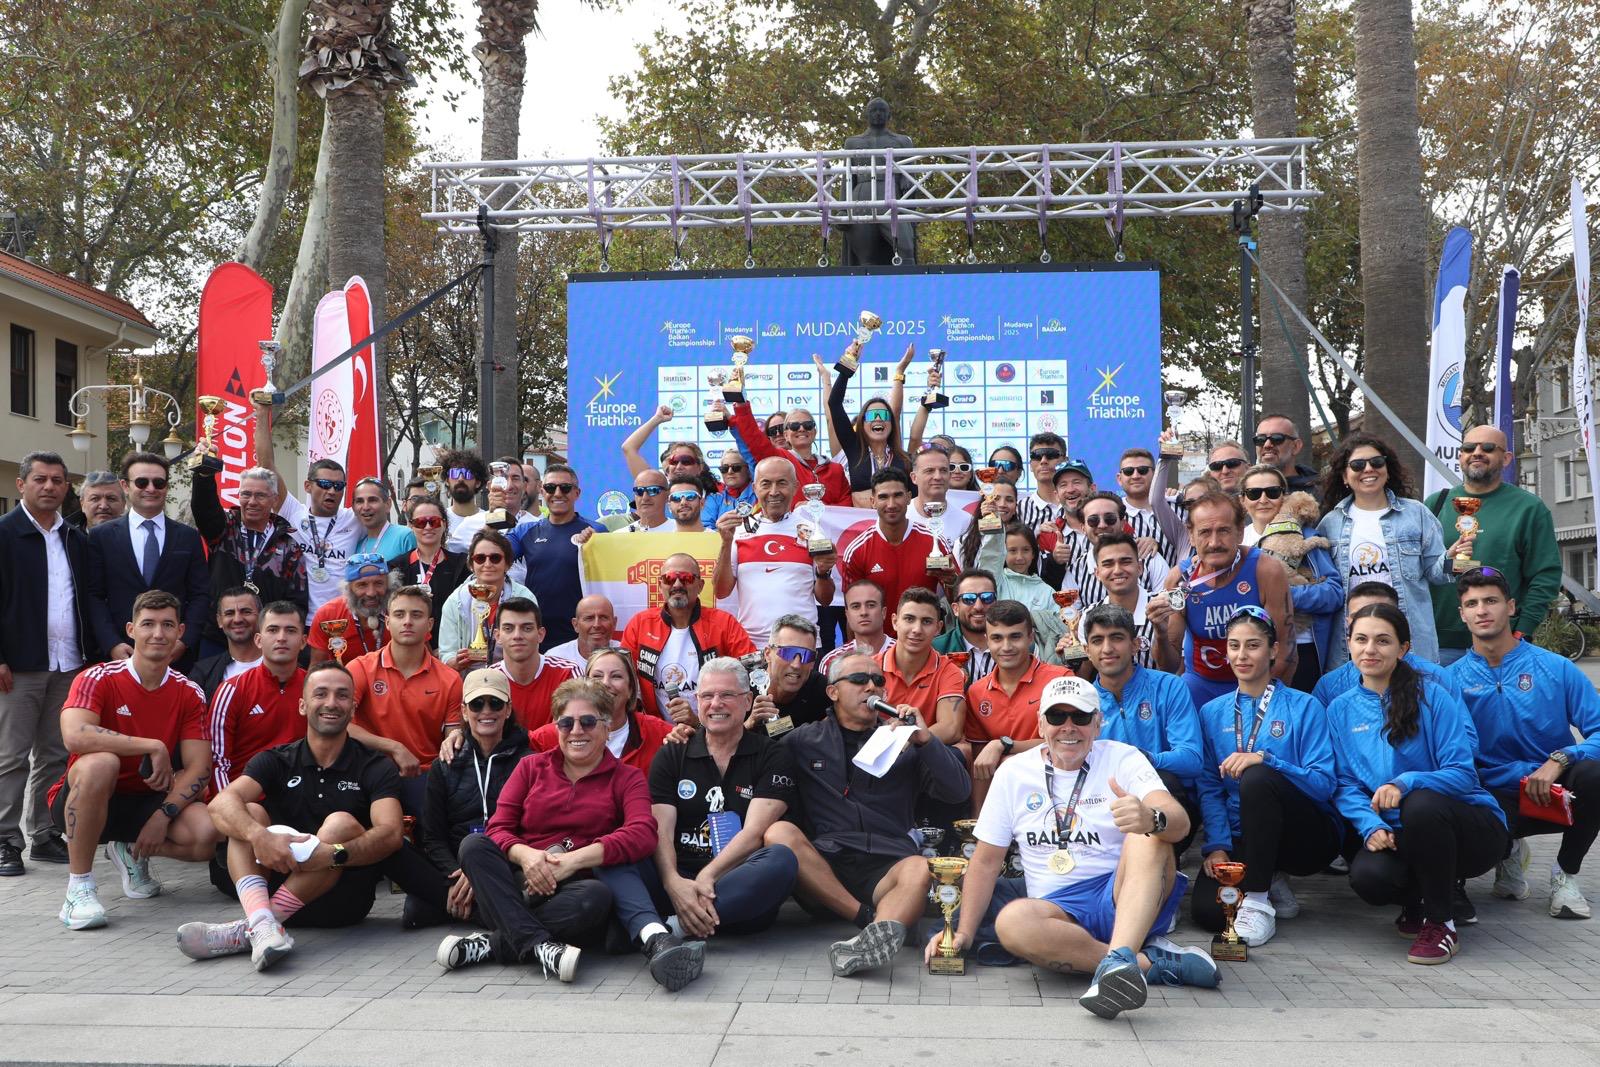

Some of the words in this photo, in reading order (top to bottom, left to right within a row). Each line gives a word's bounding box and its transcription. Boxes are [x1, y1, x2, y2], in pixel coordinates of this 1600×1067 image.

[669, 321, 692, 329] Europe
[947, 316, 970, 324] Europe
[724, 326, 753, 334] Mudanya
[886, 320, 926, 335] 2025
[668, 339, 716, 347] Championships
[946, 334, 995, 342] Championships
[1092, 393, 1140, 406] Europe
[590, 401, 637, 414] Europe
[1086, 406, 1145, 419] Triathlon
[584, 414, 642, 427] Triathlon
